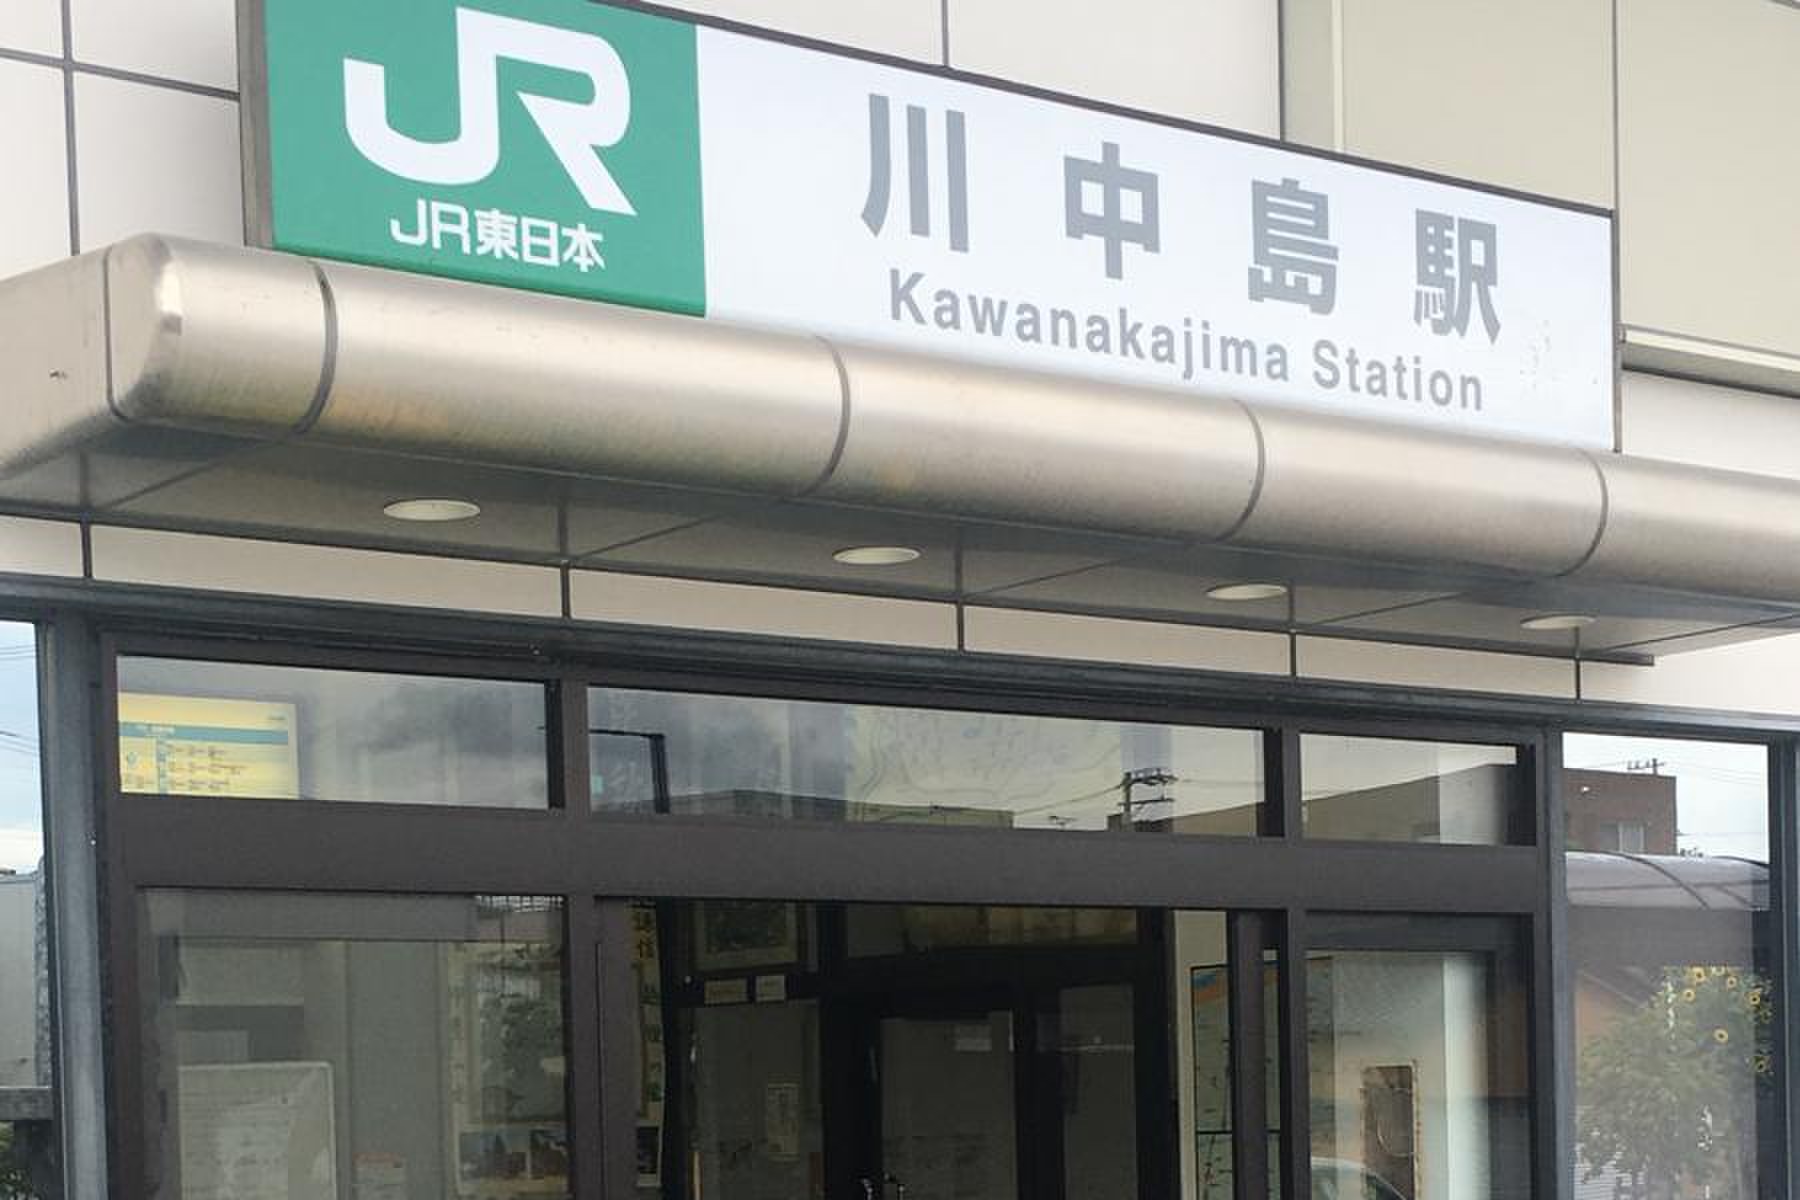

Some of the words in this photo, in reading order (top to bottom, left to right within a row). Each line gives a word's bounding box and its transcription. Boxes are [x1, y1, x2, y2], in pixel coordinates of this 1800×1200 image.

[343, 6, 637, 217] JR
[389, 199, 606, 272] JR東日本
[860, 93, 1501, 345] 川中島駅
[890, 268, 1290, 382] Kawanakajima
[1312, 339, 1484, 411] Station
